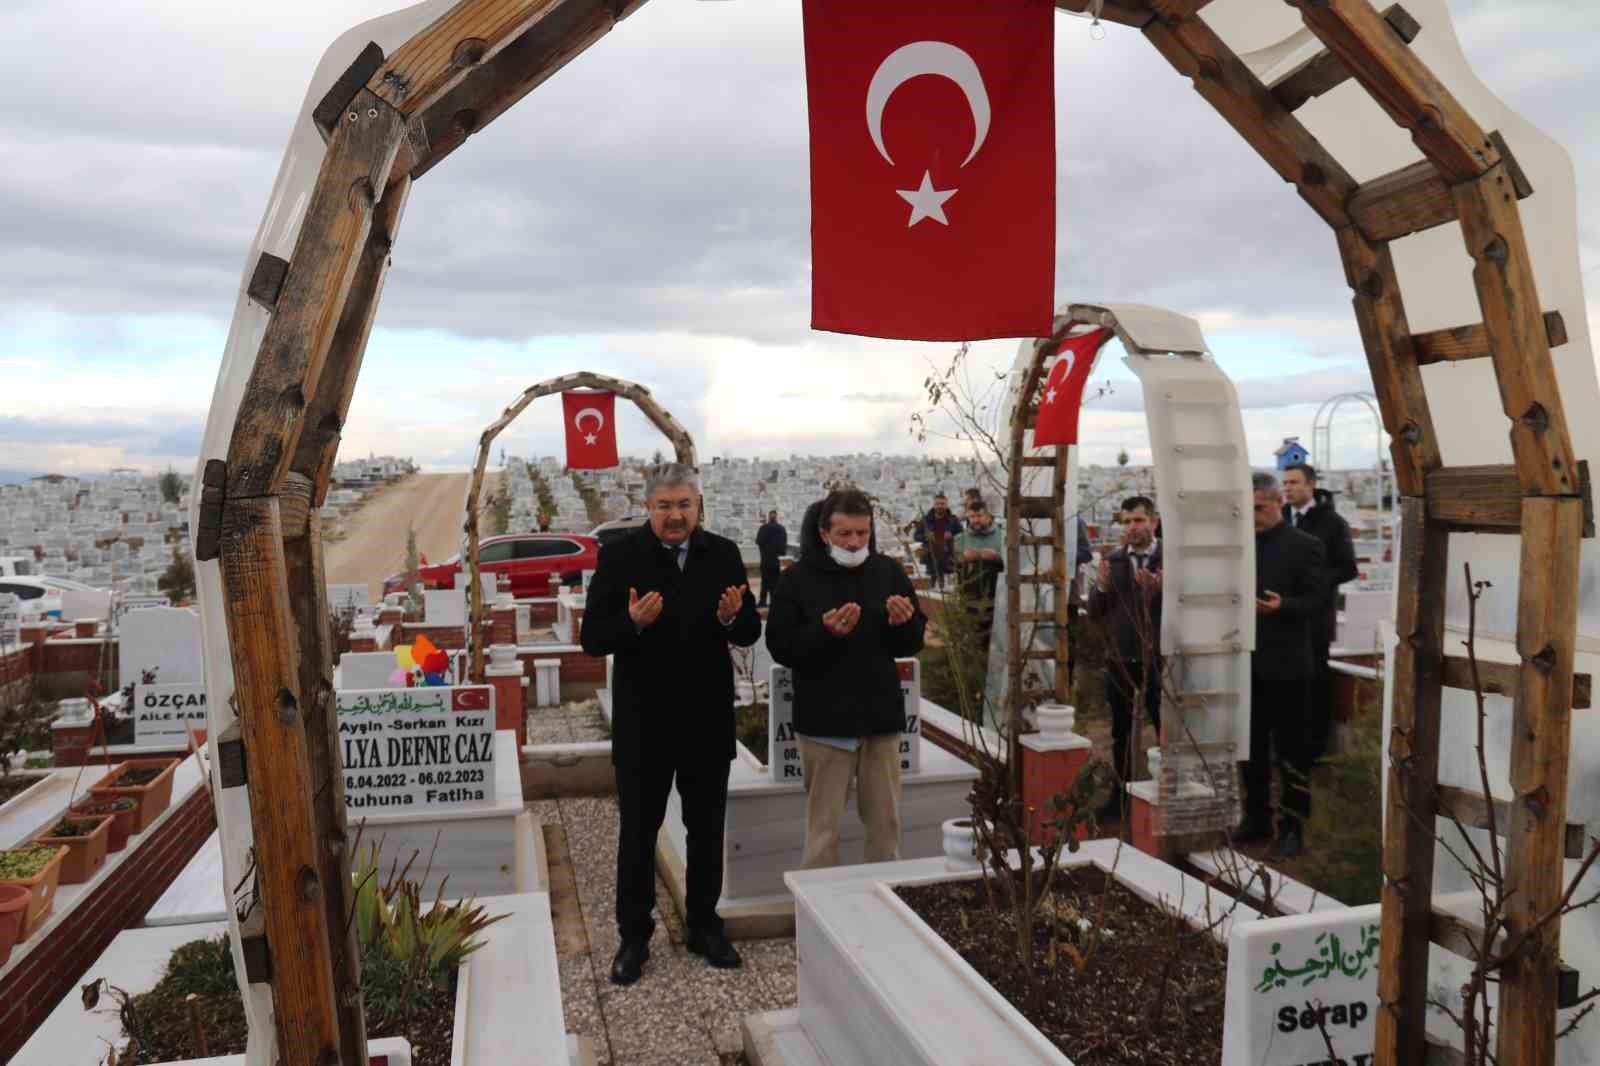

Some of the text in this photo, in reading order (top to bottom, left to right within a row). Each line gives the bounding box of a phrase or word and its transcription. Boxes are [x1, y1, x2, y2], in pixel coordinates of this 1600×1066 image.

[339, 720, 382, 735] Ayşin
[455, 716, 485, 728] Kızı
[342, 732, 493, 770] LYA DEFNE CAZ
[343, 774, 407, 790] 6.04.2022
[418, 768, 485, 785] 06.02.2023
[426, 788, 485, 804] Fatiha
[1277, 1001, 1368, 1033] Serap
